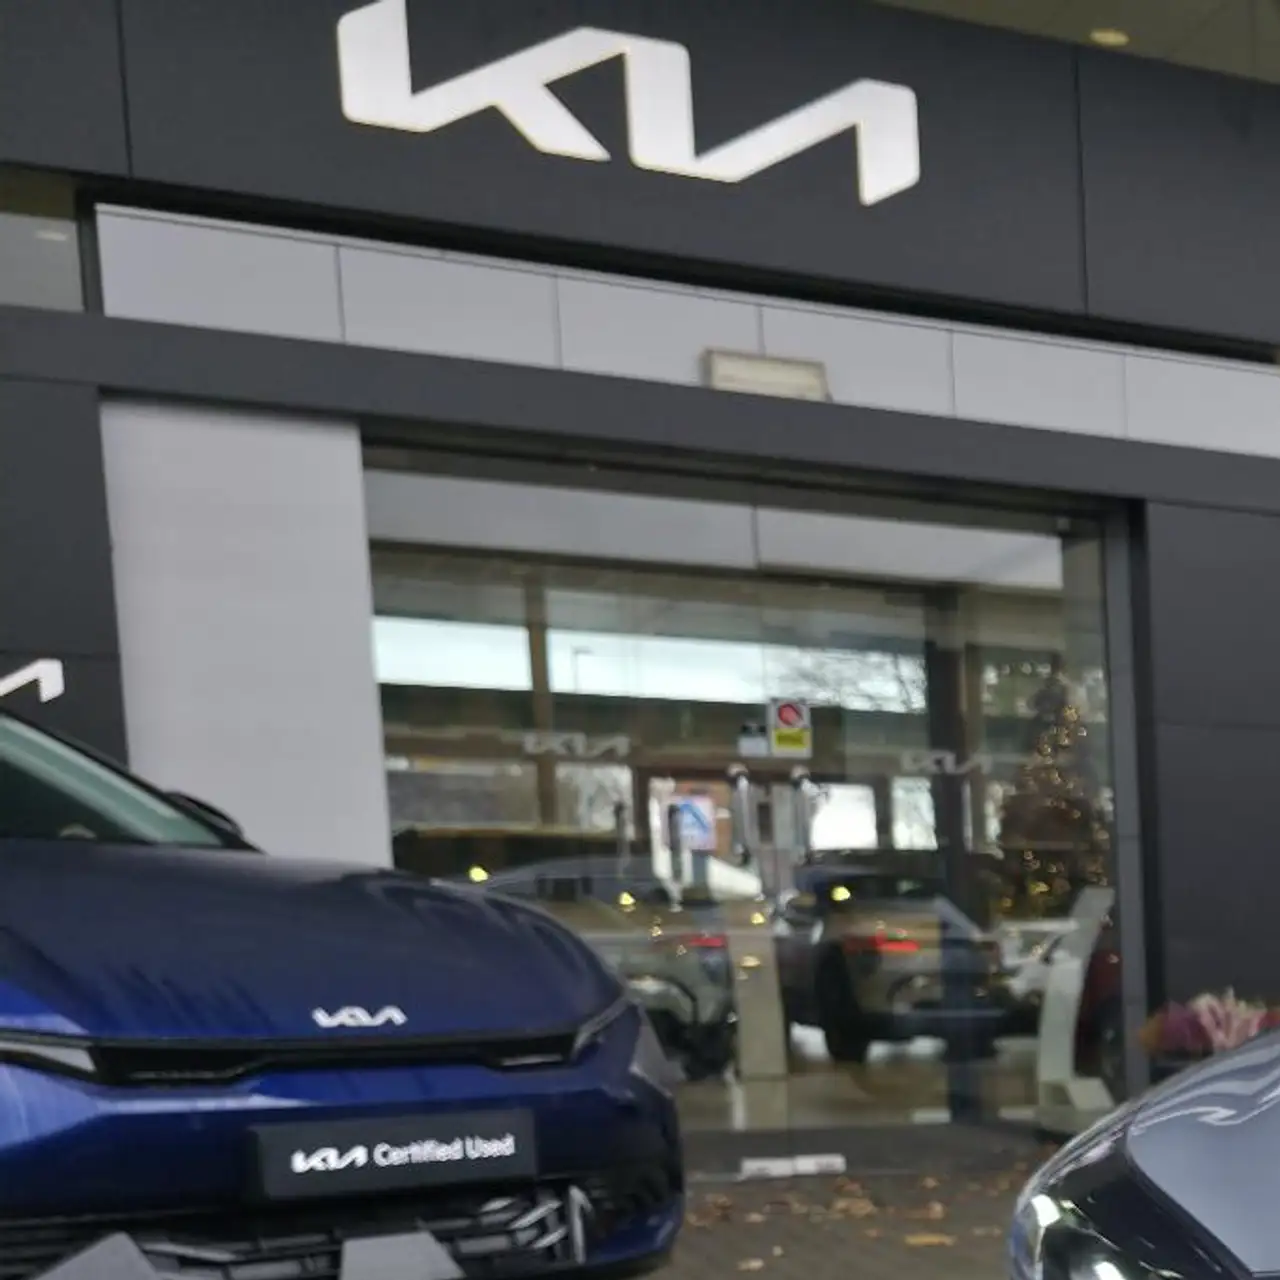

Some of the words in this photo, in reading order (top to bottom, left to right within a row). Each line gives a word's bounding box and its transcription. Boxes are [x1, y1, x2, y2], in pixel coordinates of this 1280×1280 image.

[337, 0, 920, 206] KIA
[312, 1005, 408, 1028] KIA
[290, 1145, 369, 1174] KIA
[372, 1138, 464, 1167] Certified
[464, 1132, 516, 1159] Used
